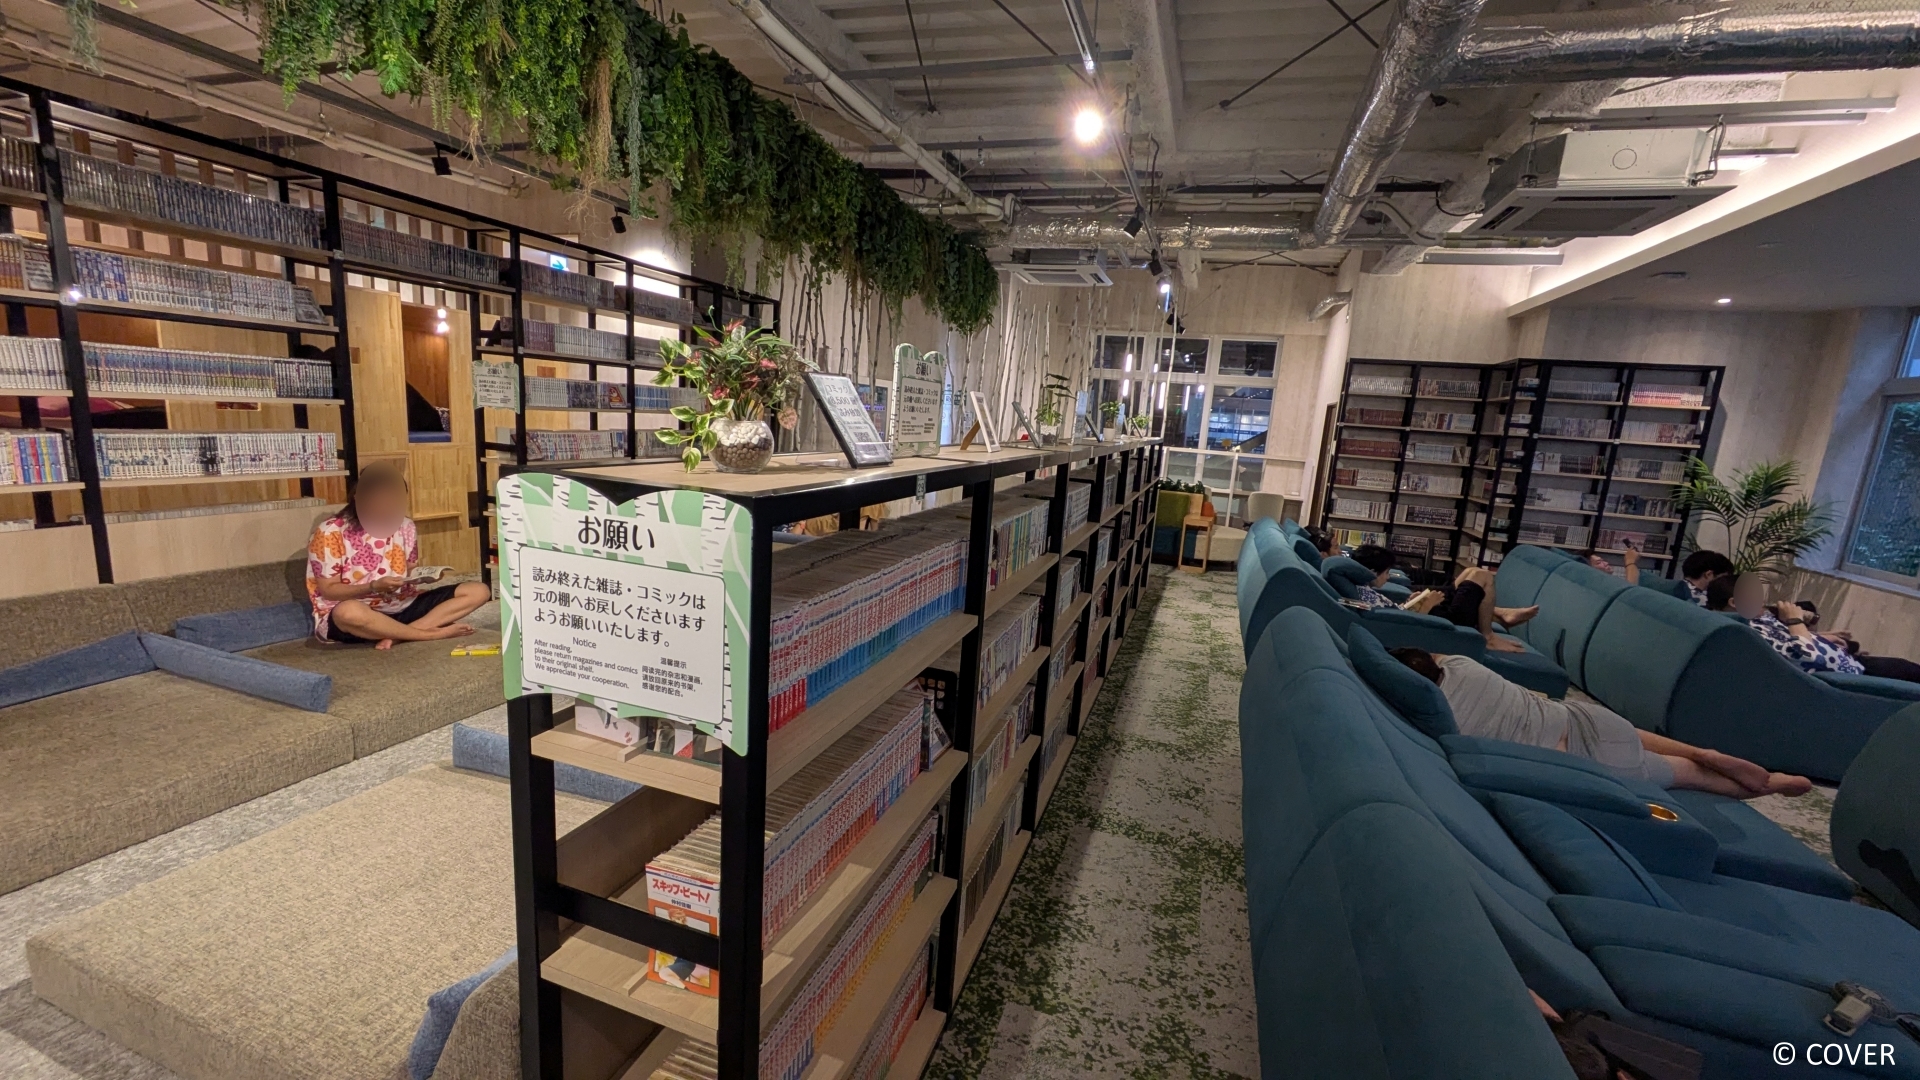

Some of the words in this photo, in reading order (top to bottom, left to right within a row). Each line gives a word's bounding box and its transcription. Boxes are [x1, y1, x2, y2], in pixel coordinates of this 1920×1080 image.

[916, 362, 932, 376] お願い
[577, 515, 656, 551] お願い
[532, 566, 707, 611] 読み終えた雑誌・コミックは
[532, 587, 707, 633] 元の棚へお戻しくださいます
[533, 608, 670, 648] ようお願いいたします。
[534, 638, 548, 647] After
[572, 636, 597, 649] Notice
[534, 647, 553, 658] please
[554, 650, 572, 660] return
[572, 654, 603, 668] magazines
[604, 660, 616, 670] and
[617, 664, 638, 675] comics
[542, 656, 556, 665] their
[556, 659, 578, 670] original
[578, 663, 594, 673] shelf.
[660, 657, 687, 669] 温馨提示
[535, 662, 545, 671] We
[546, 665, 577, 679] appreciate
[577, 672, 591, 682] your
[591, 675, 630, 689] cooperation.
